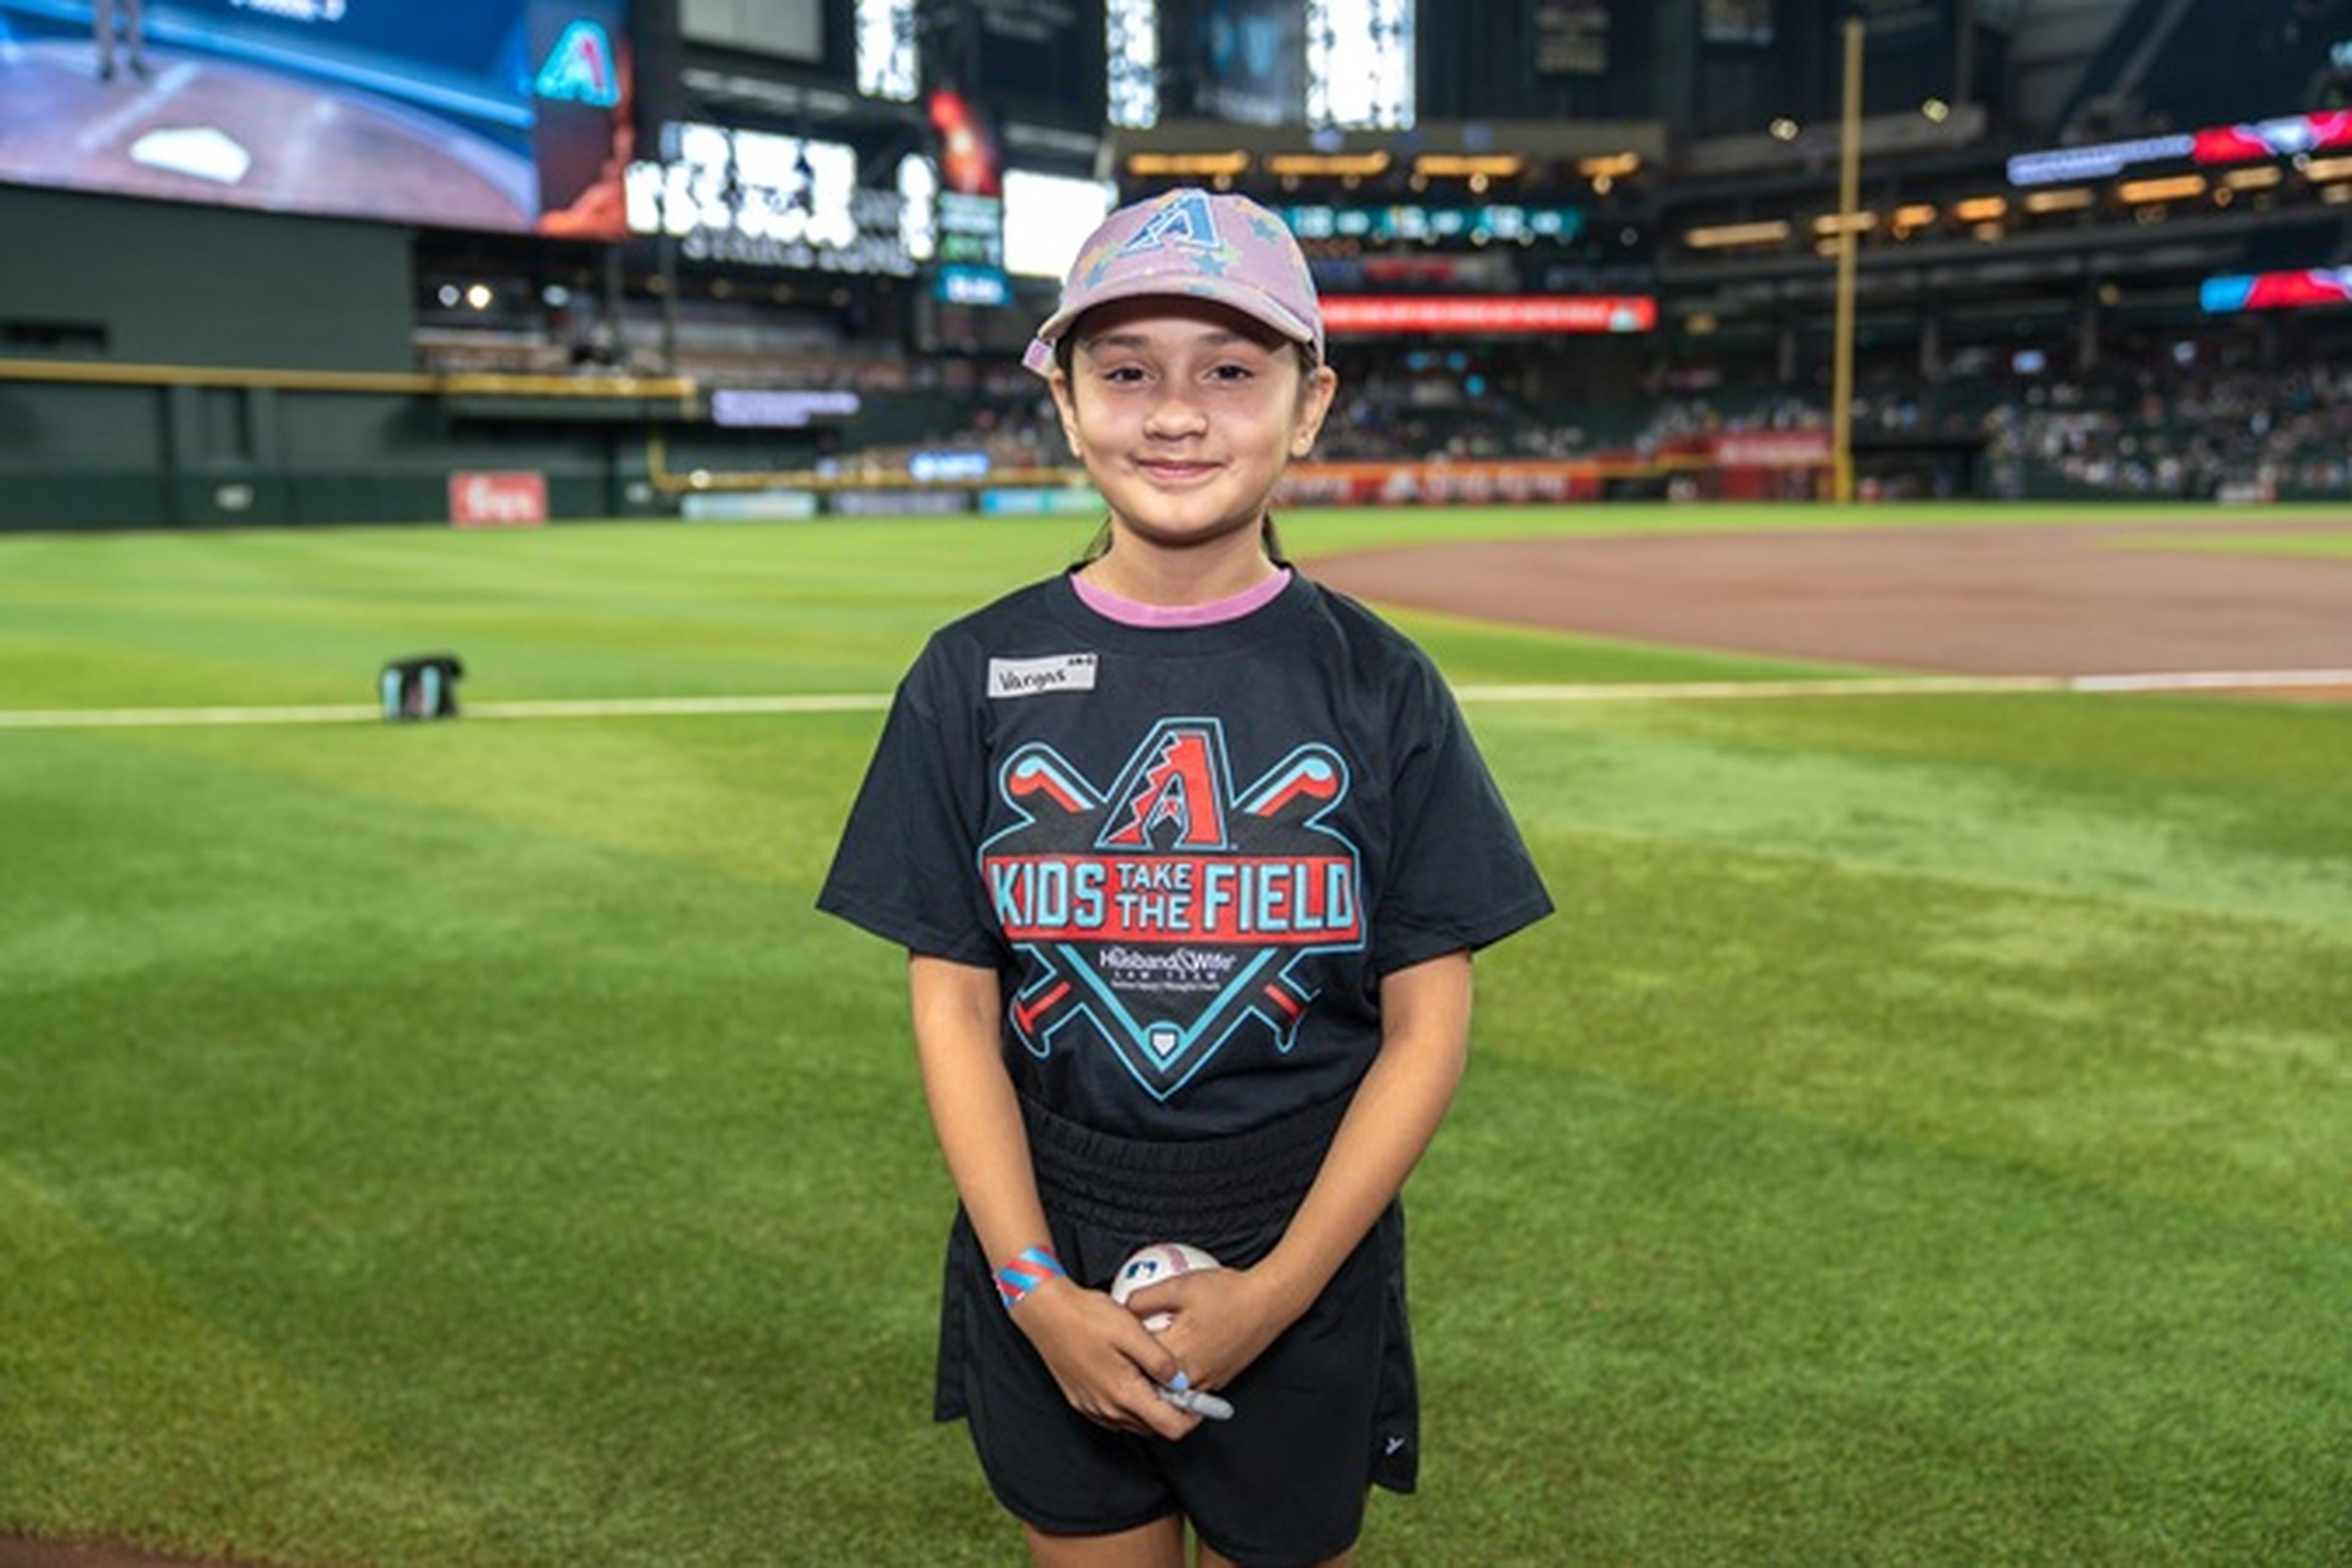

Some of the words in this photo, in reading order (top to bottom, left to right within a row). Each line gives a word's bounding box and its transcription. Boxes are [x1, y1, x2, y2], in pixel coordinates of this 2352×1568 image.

[990, 863, 1105, 927] KIDS
[1116, 864, 1192, 889] TAKE
[1204, 863, 1352, 930] FIELD
[1115, 895, 1191, 929] THE
